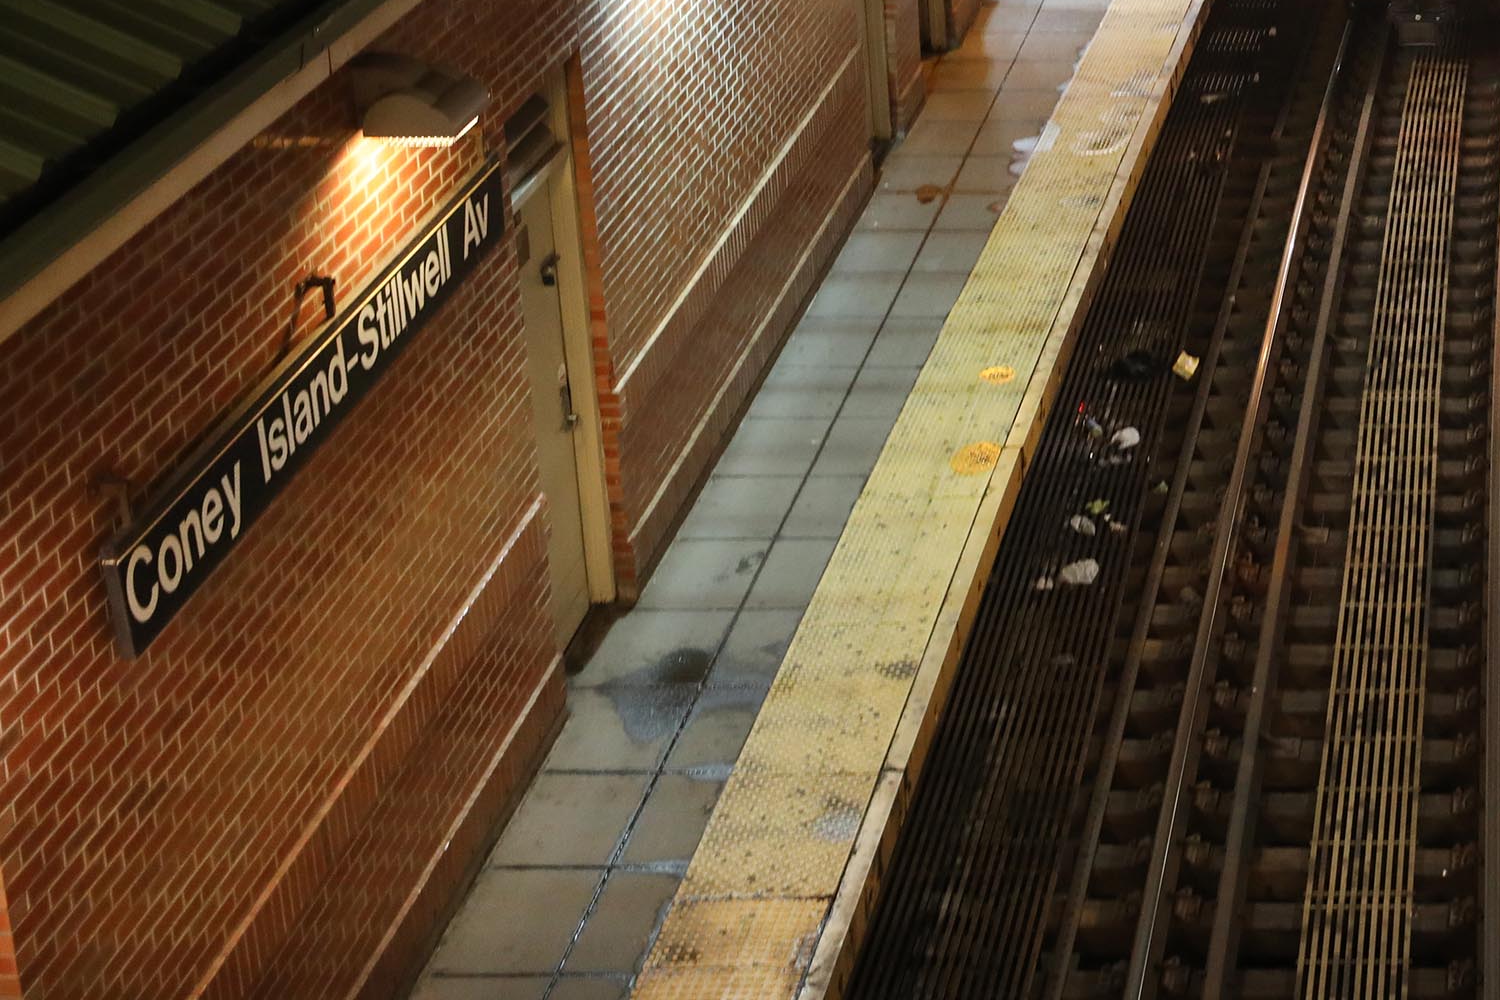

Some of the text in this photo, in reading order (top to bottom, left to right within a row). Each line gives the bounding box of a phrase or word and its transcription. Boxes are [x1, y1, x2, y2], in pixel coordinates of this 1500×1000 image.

[125, 191, 490, 624] Coney Island-Stillwell Av
